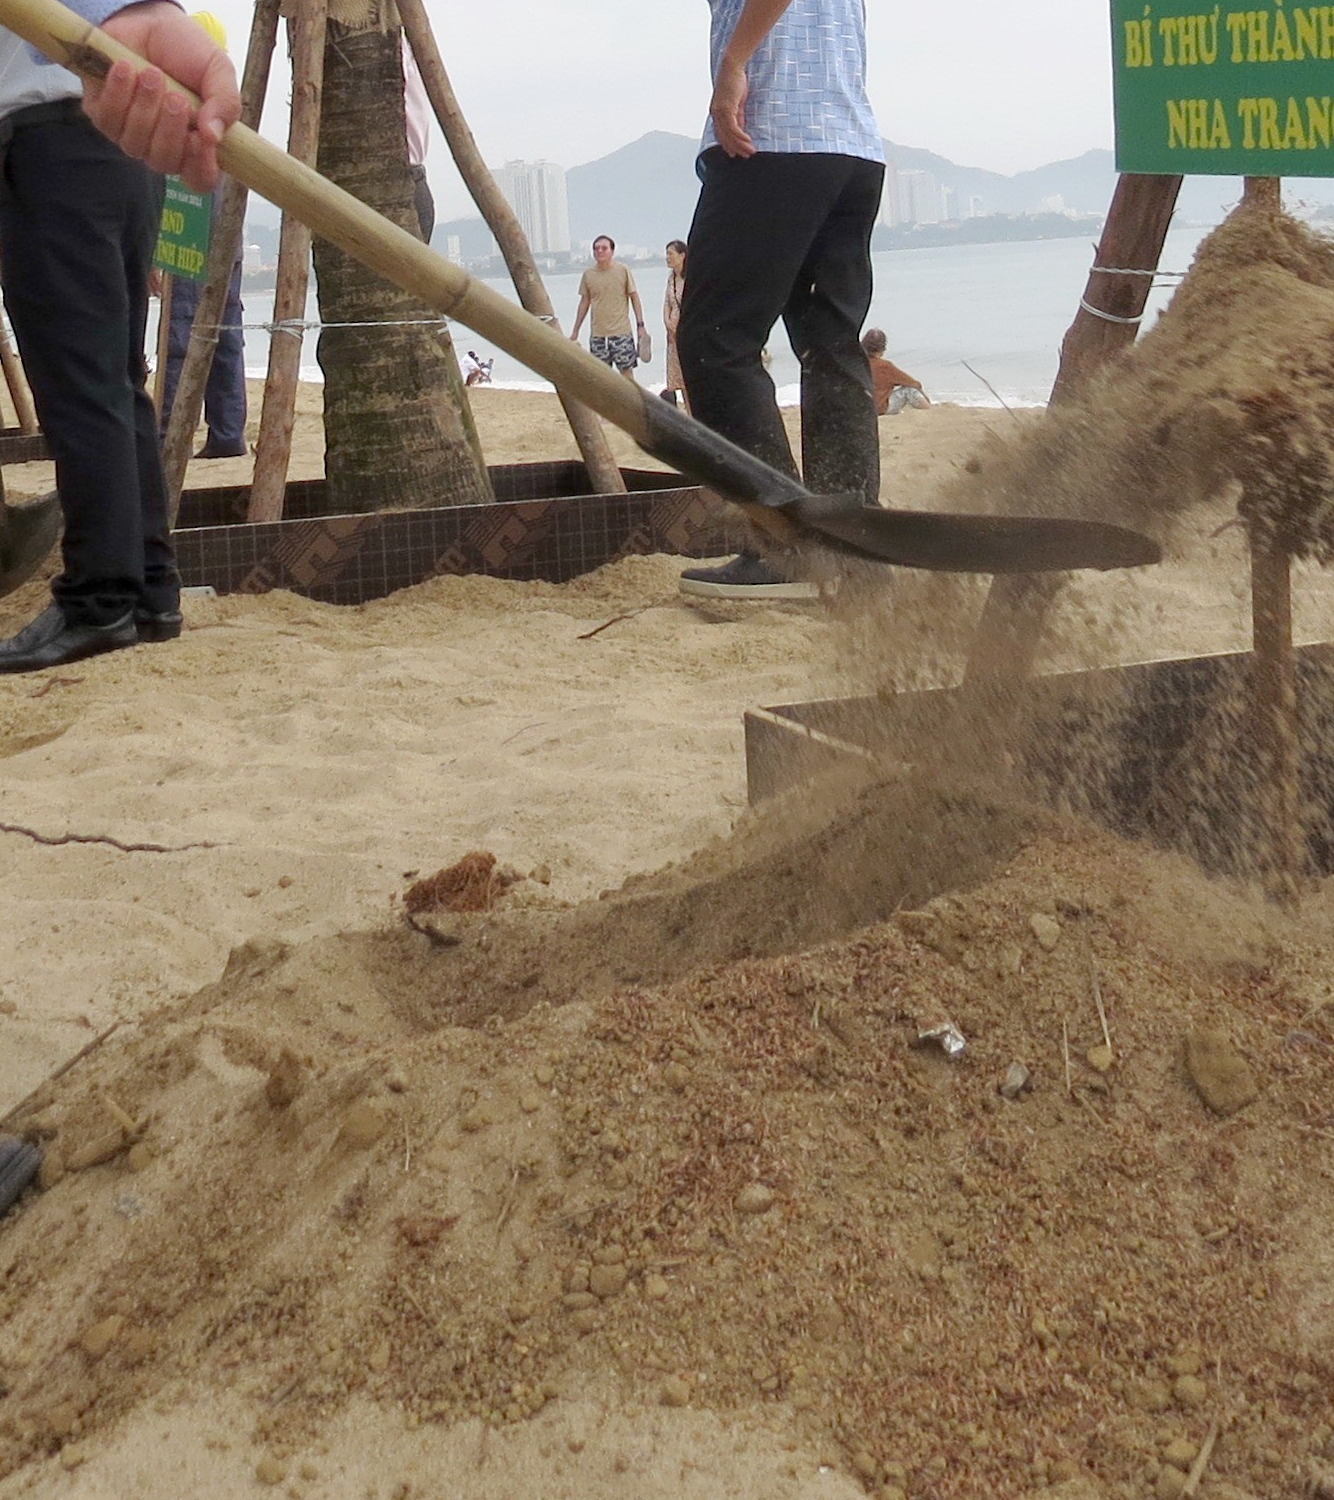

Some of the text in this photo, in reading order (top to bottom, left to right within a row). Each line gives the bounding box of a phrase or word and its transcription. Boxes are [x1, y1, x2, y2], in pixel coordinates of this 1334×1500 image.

[1124, 4, 1154, 68] BÍ
[1159, 3, 1221, 67] THƯ
[1166, 98, 1232, 150] NHA
